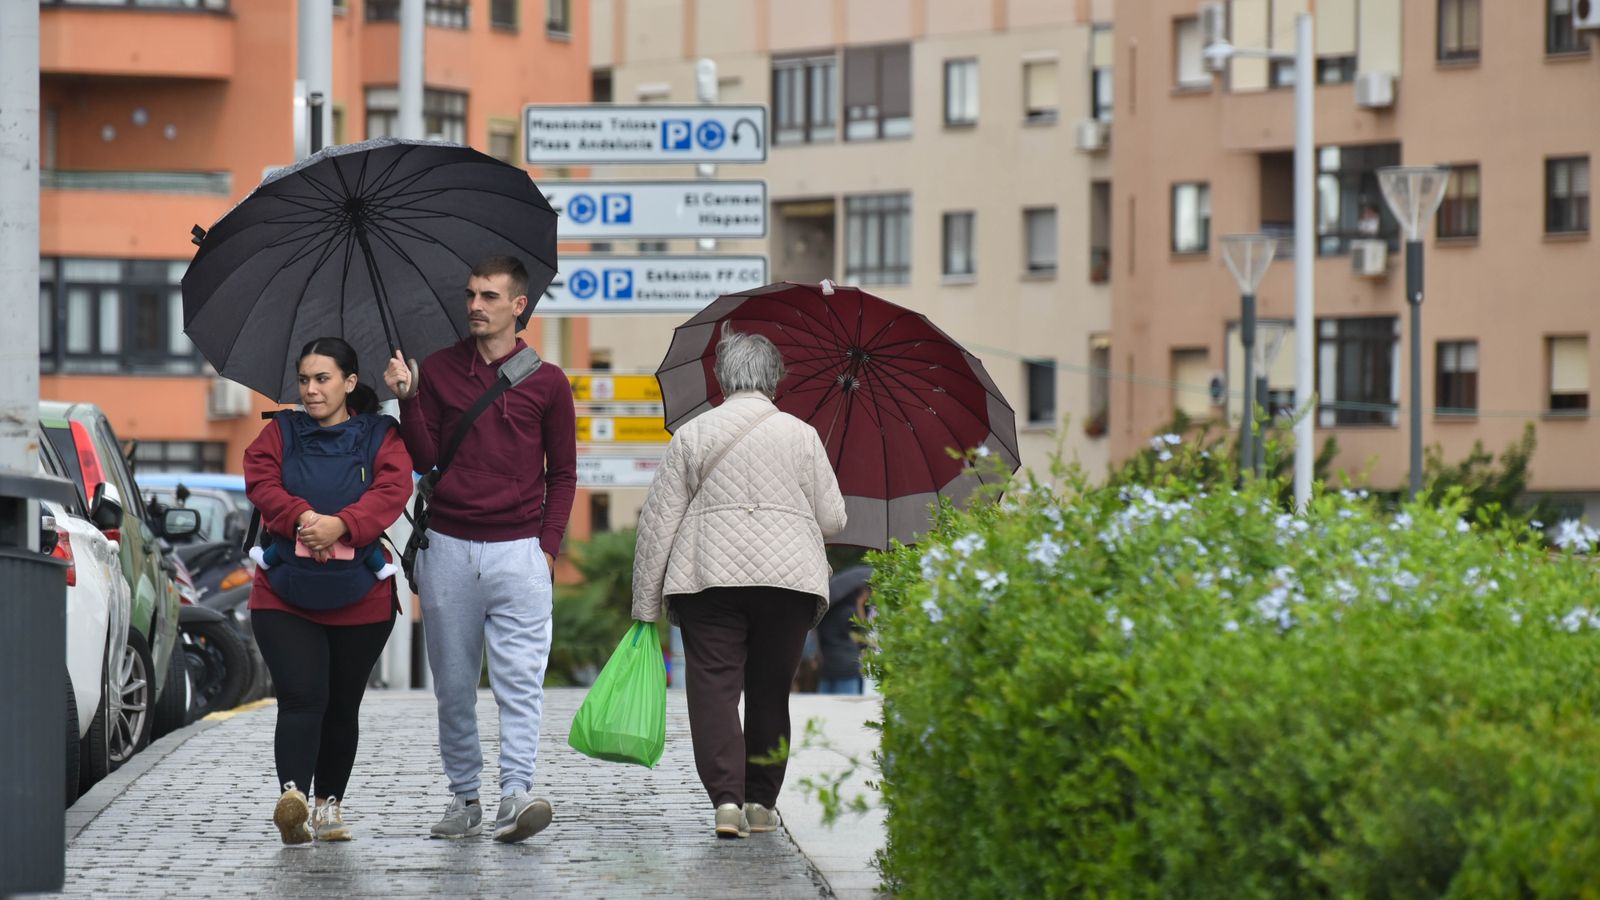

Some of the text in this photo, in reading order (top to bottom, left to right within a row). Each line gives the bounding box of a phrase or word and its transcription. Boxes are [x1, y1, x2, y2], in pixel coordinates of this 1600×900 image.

[666, 121, 690, 149] P
[607, 195, 630, 223] P
[684, 192, 761, 207] El Carmen
[608, 270, 631, 298] P
